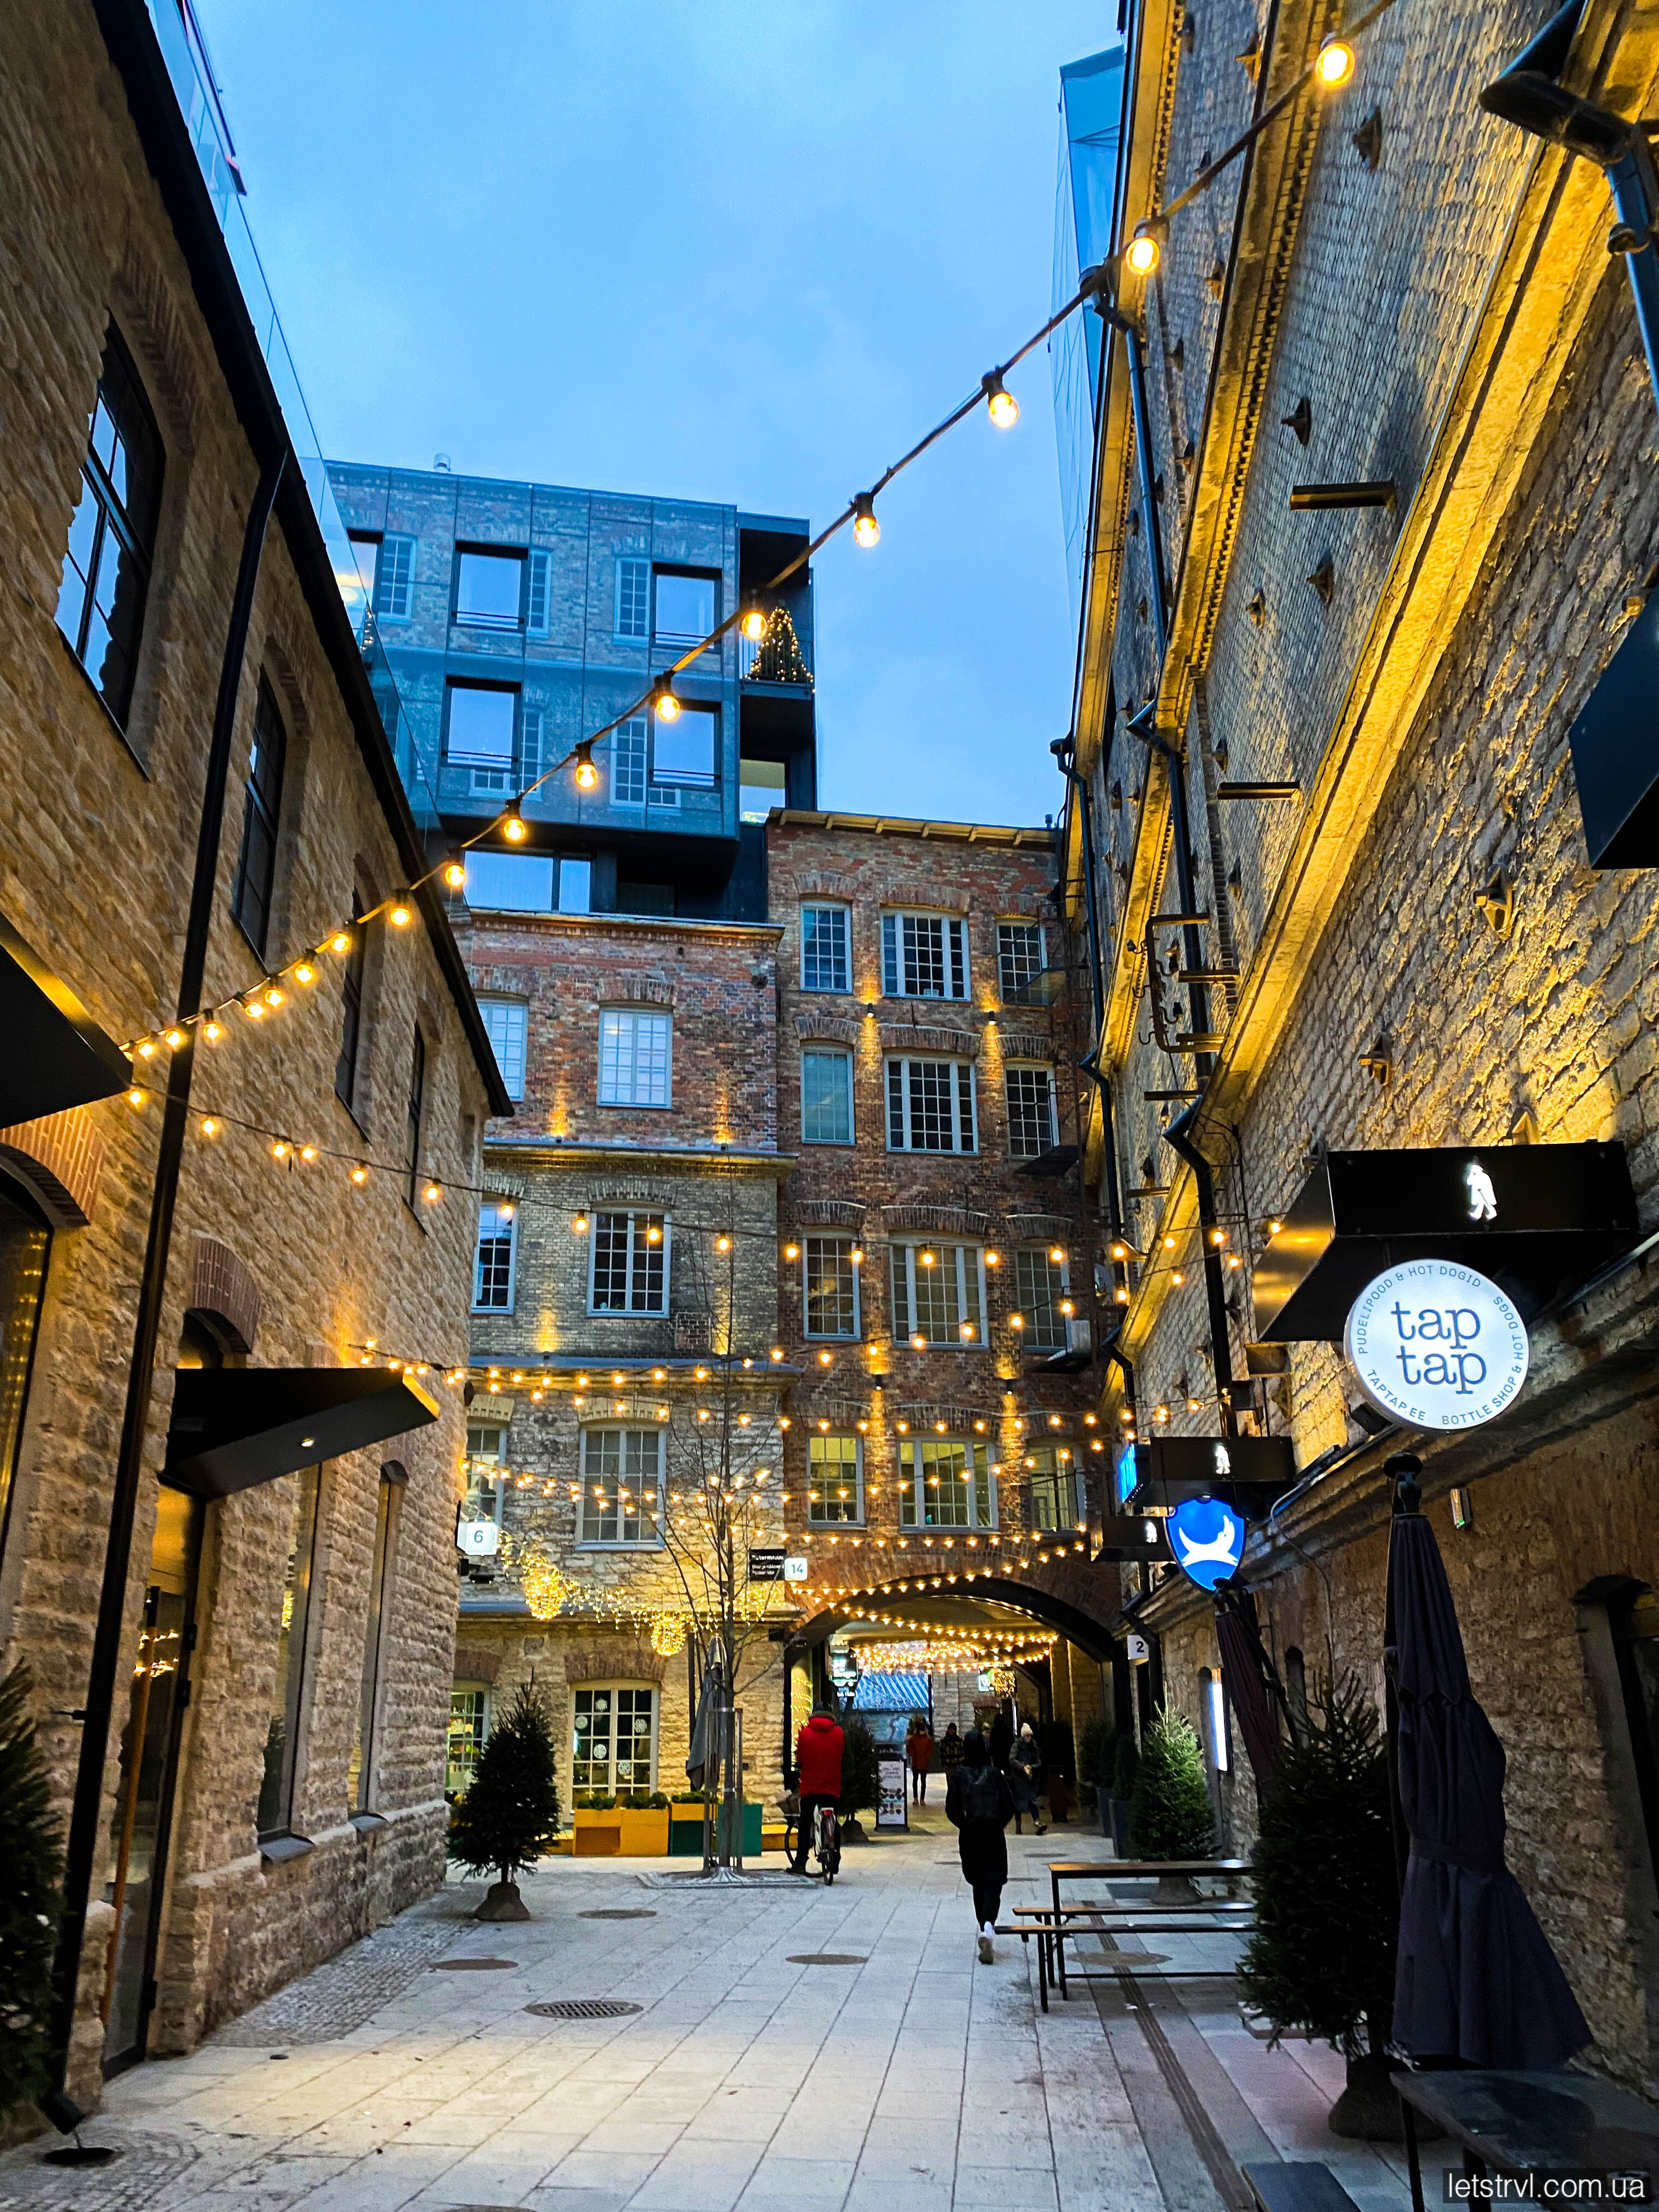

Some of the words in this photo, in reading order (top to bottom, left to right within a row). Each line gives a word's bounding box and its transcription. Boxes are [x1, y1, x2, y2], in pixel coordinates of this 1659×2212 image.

[1357, 1279, 1392, 1353] PUDELIPOOD
[1396, 1272, 1404, 1281] &
[1408, 1266, 1434, 1277] HOT
[1440, 1266, 1481, 1287] DOGID
[1391, 1301, 1481, 1349] tap
[1493, 1296, 1519, 1330] DOGS
[1512, 1335, 1523, 1361] HOT
[1396, 1345, 1487, 1395] tap
[1367, 1369, 1426, 1421] TAPTAP.EE
[1493, 1375, 1516, 1407] SHOP
[1442, 1404, 1492, 1425] BOTTLE
[473, 1530, 483, 1543] 6
[791, 1564, 804, 1573] 14
[1136, 1641, 1145, 1652] 2
